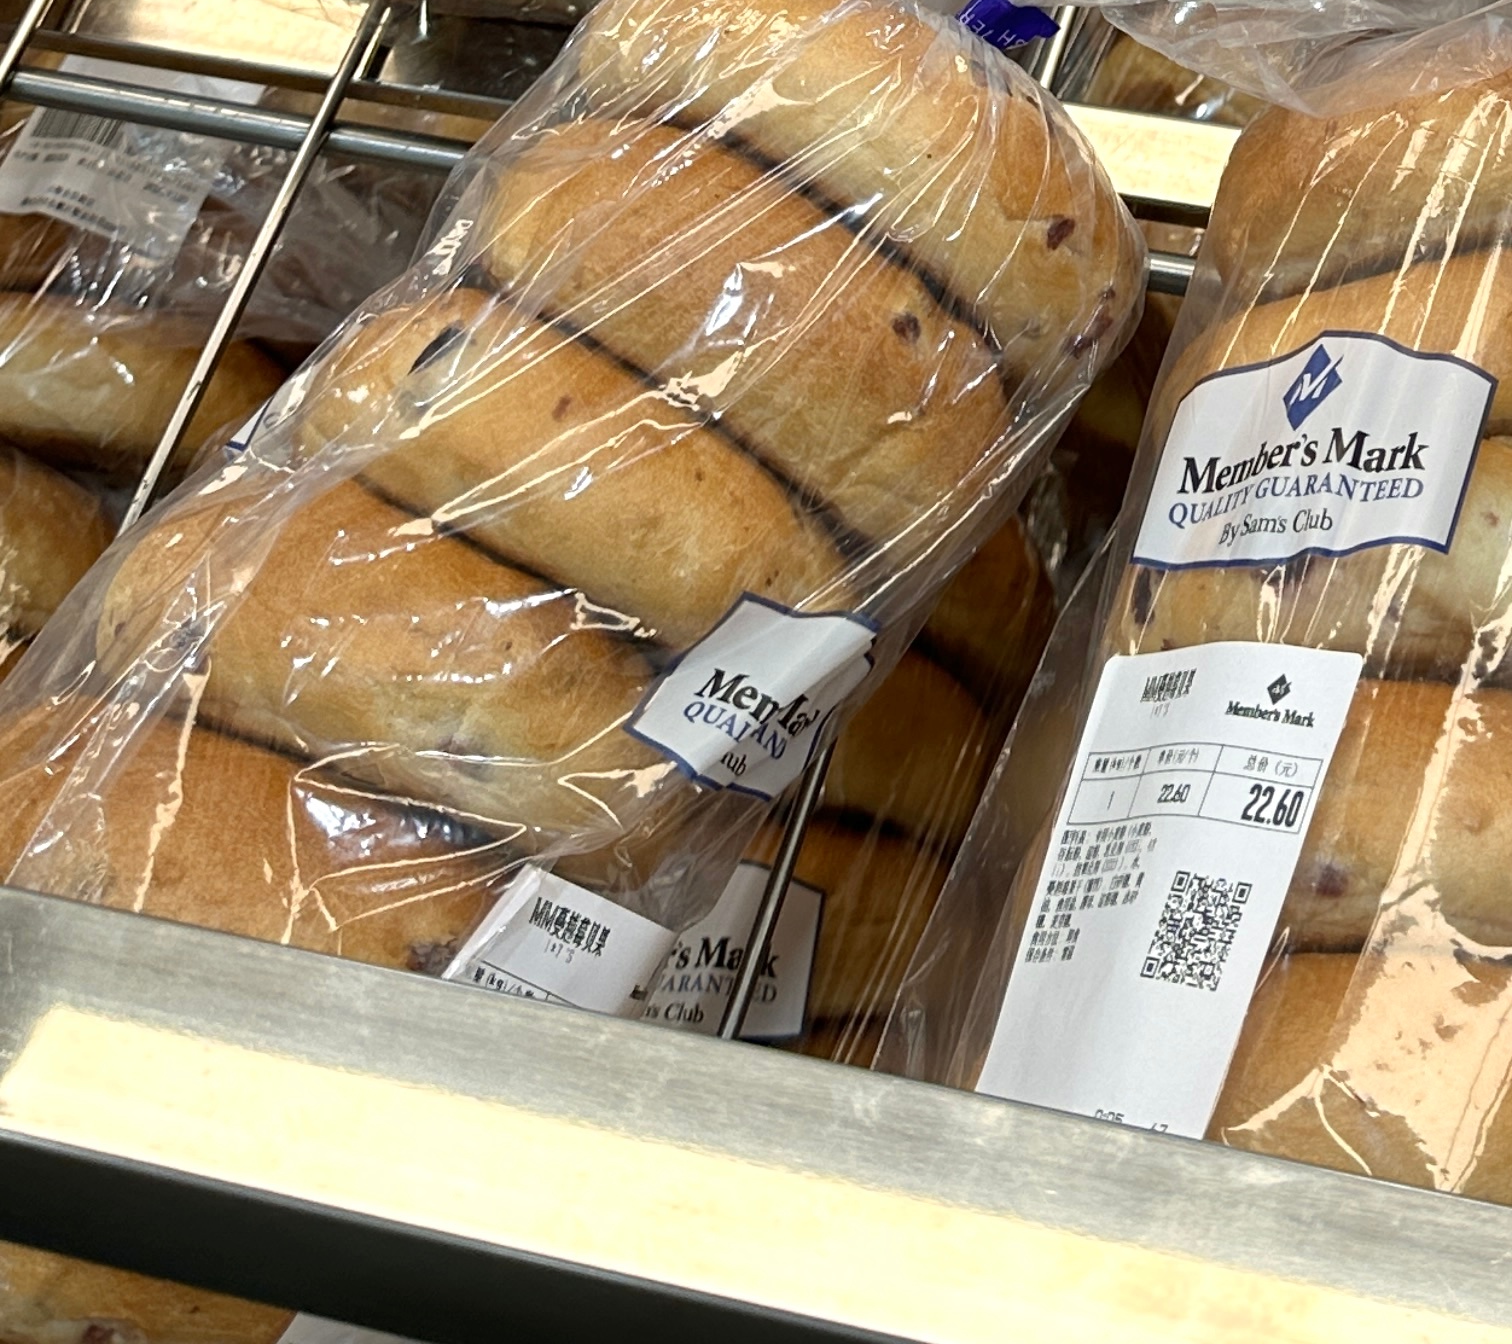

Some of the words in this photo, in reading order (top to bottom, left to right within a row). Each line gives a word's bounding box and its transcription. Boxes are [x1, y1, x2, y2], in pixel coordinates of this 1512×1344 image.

[1177, 434, 1318, 494] Member's
[1322, 427, 1429, 472] Mark
[1168, 485, 1255, 529] QUALITY
[1255, 472, 1424, 504] GUARANTEED
[1219, 523, 1240, 546] By
[1241, 513, 1286, 536] Sam's
[1292, 508, 1333, 534] Club
[1225, 701, 1281, 722] Member's
[1281, 708, 1315, 728] Mark
[1157, 784, 1191, 804] 22.60
[1241, 783, 1304, 829] 22.60
[698, 936, 777, 979] Mak
[664, 1002, 705, 1024] Club
